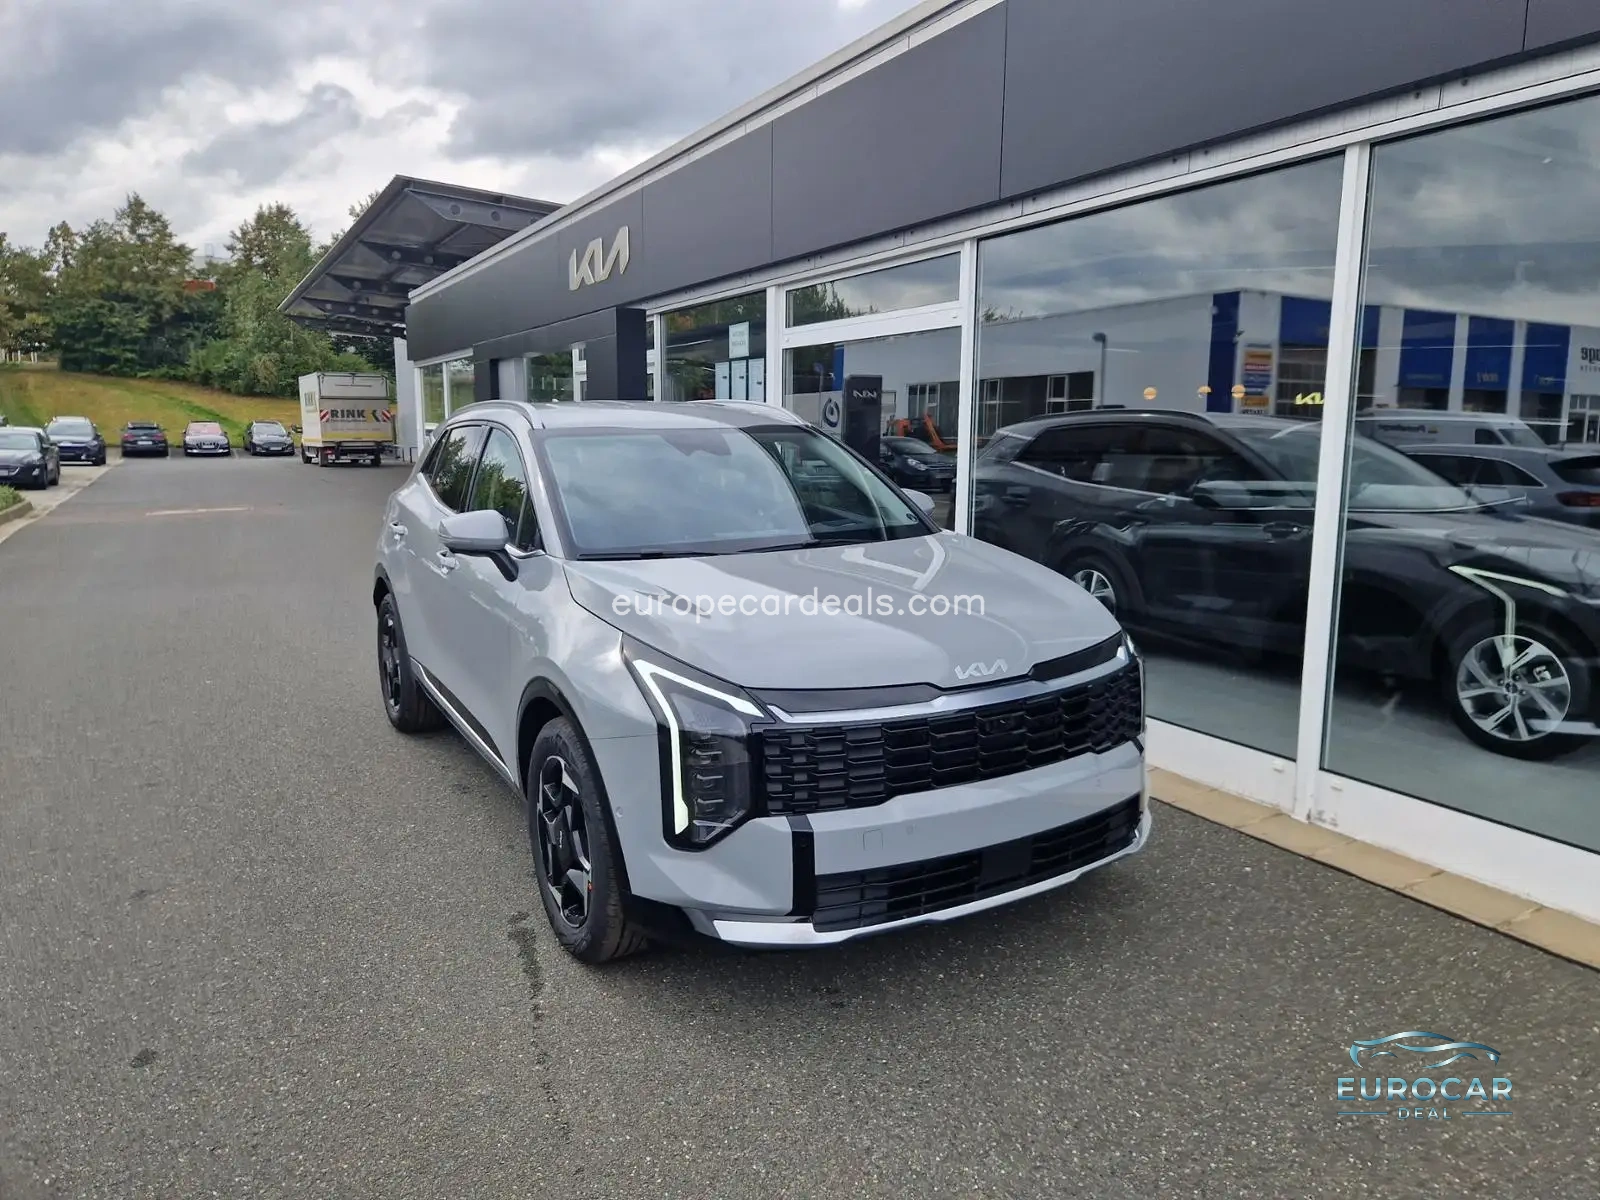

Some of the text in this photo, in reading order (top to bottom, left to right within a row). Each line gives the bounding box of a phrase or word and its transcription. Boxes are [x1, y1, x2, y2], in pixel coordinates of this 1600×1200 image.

[568, 225, 629, 291] KIA
[1295, 391, 1324, 404] KI
[331, 409, 366, 418] RINK
[954, 659, 1008, 679] KIA
